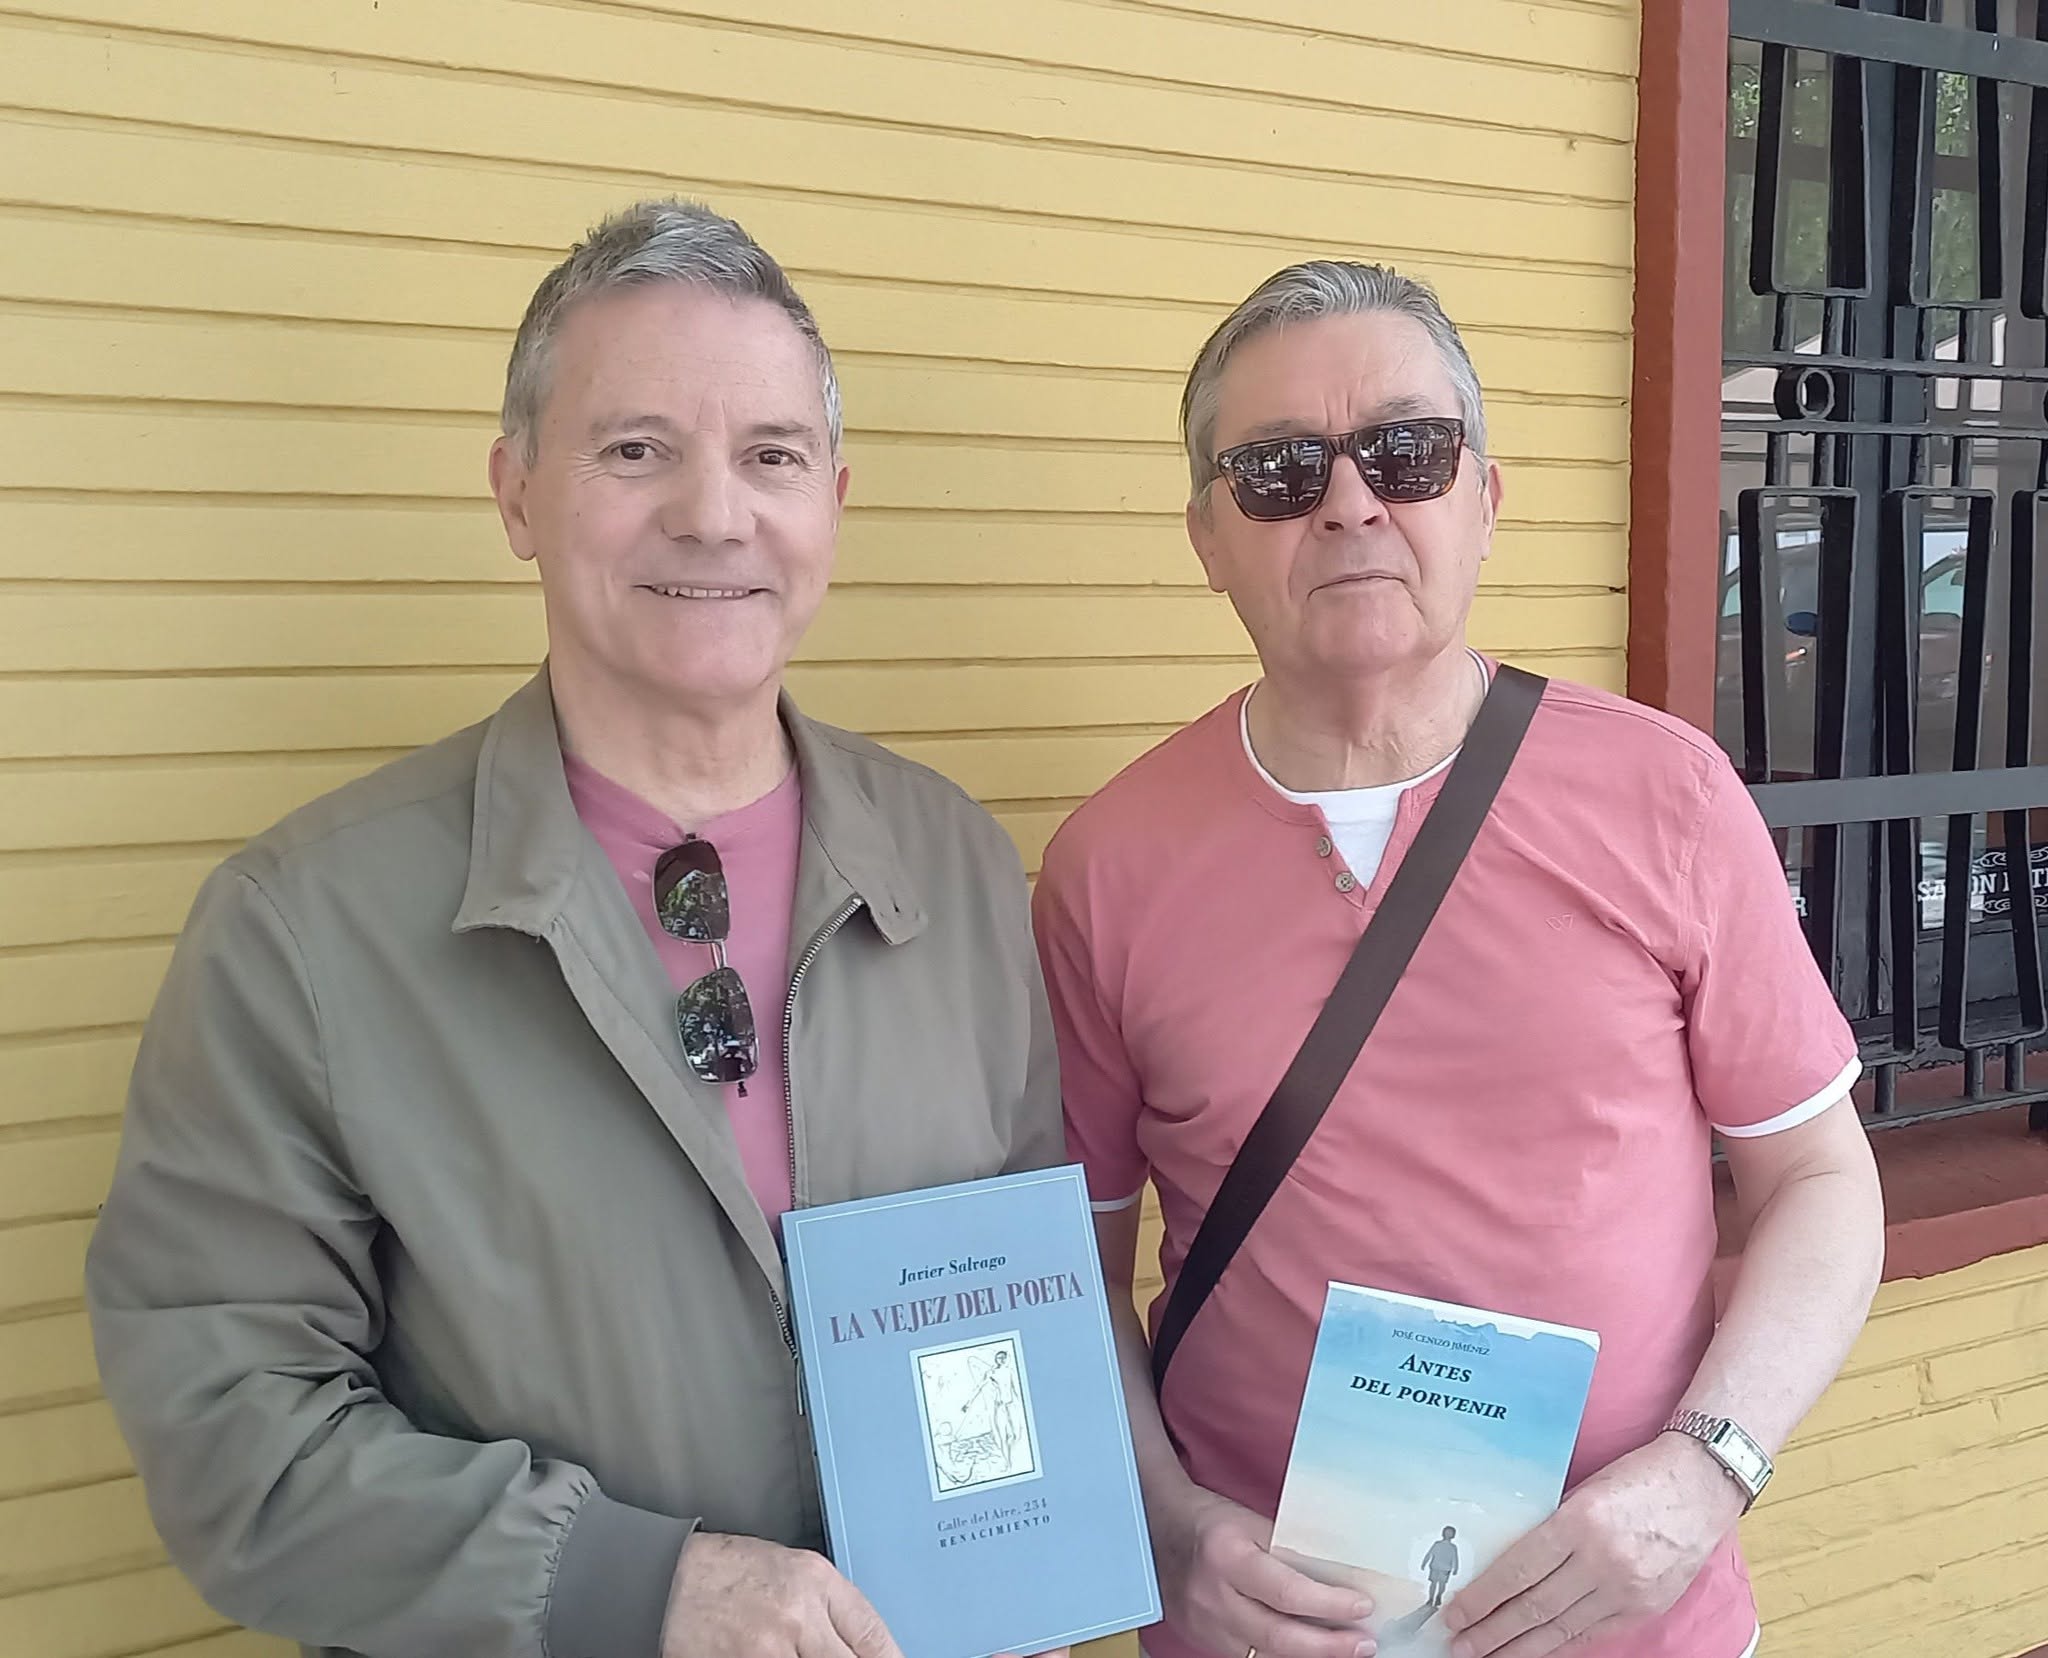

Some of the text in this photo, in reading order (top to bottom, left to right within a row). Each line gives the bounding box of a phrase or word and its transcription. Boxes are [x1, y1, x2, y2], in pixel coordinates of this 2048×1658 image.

[898, 1255, 1007, 1286] Javier Salvago
[829, 1271, 1085, 1344] LA VEJEZ DEL POETA
[1391, 1328, 1491, 1356] JOSÉ CENIZO JIMÉNEZ
[1350, 1375, 1508, 1420] DEL PORVENIR
[937, 1517, 969, 1532] Calle
[970, 1511, 989, 1525] del
[939, 1515, 1050, 1548] RENACIMIENTO
